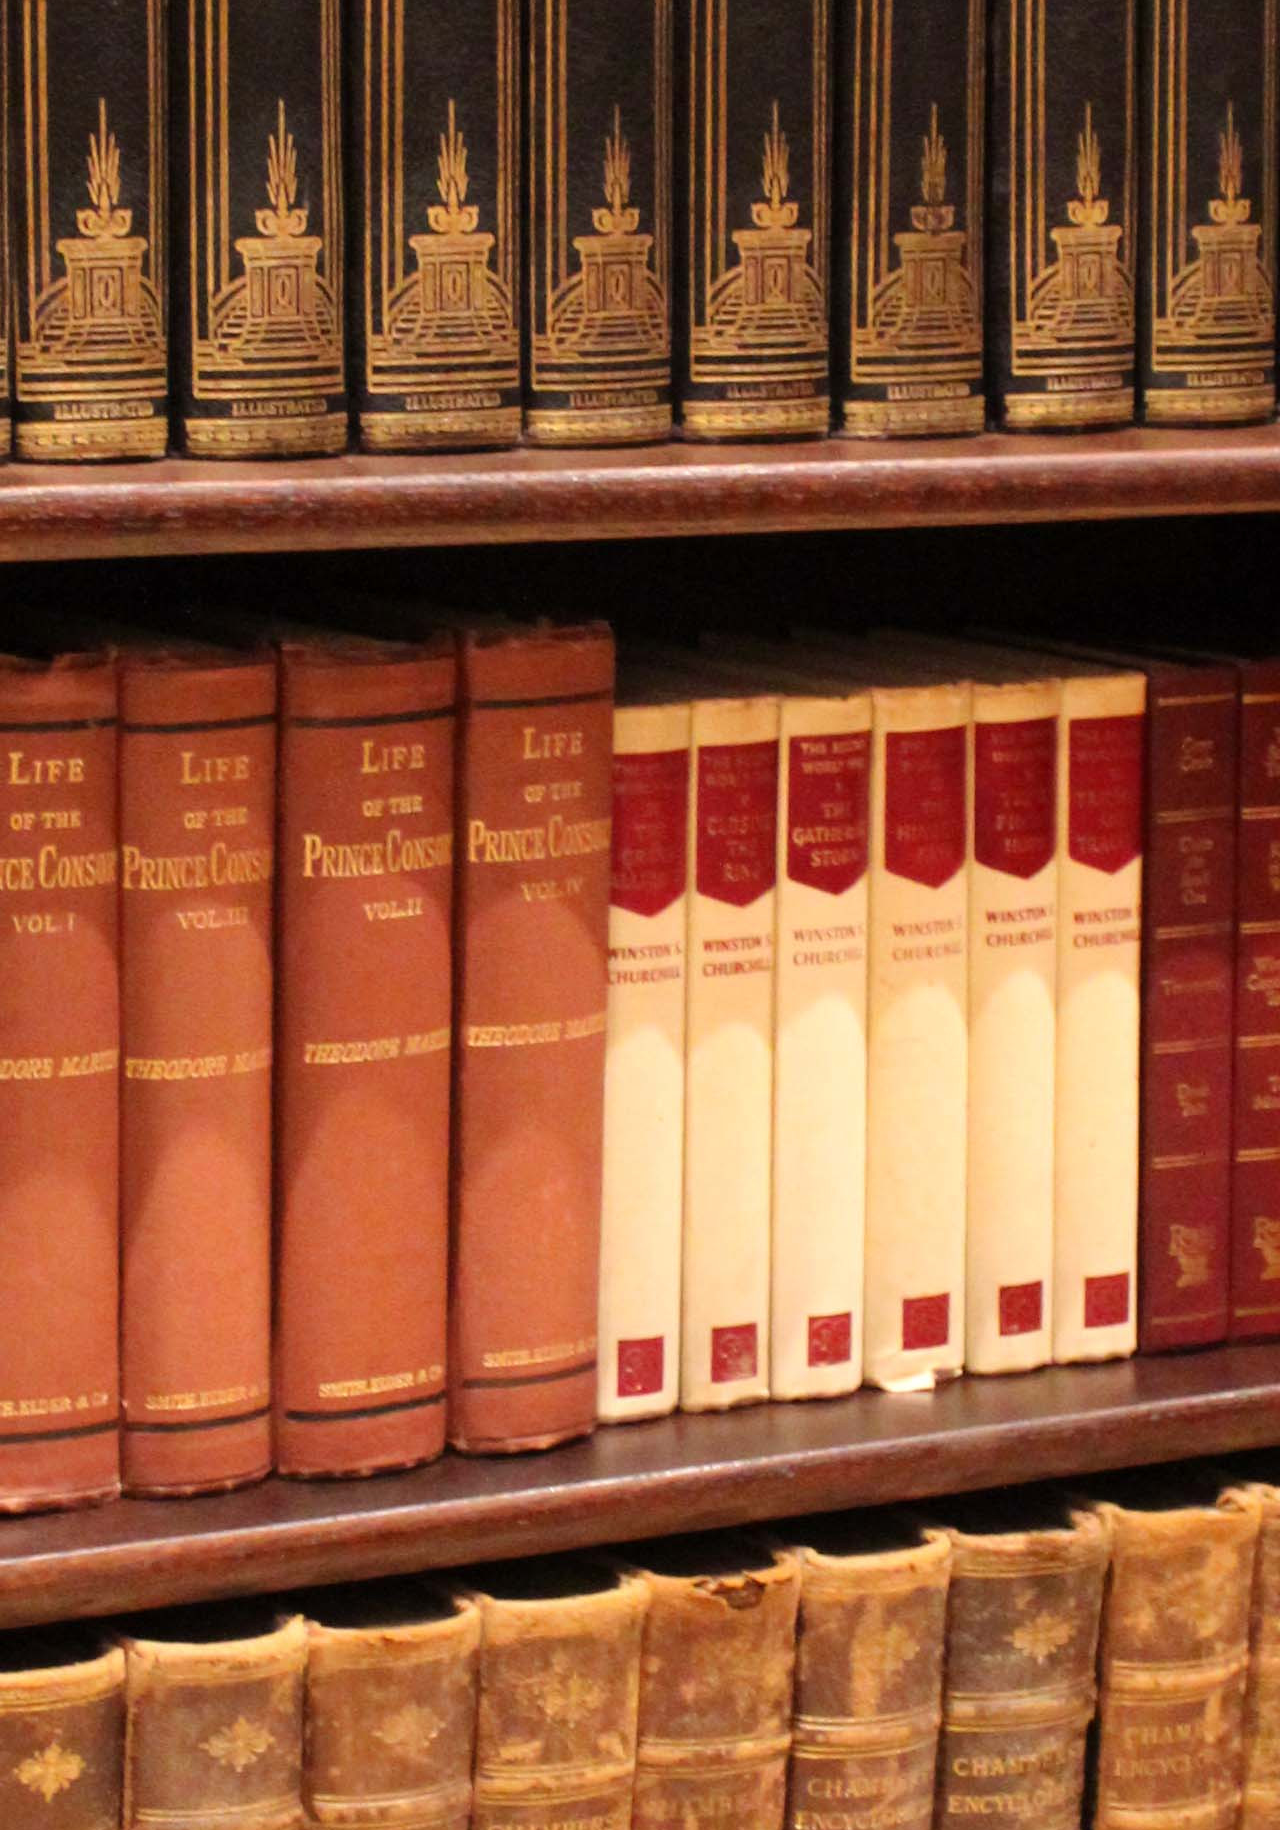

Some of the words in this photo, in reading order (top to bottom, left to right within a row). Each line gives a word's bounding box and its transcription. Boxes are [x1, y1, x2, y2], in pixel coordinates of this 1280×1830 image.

[361, 739, 426, 775] LIFE
[522, 726, 583, 760] LIFE
[8, 751, 85, 786] LIFE
[180, 750, 251, 785] LIFE
[362, 798, 385, 818] OF
[523, 783, 547, 804] OF
[9, 812, 36, 831] OF
[183, 810, 210, 830] OF
[302, 833, 385, 878] PRINCE
[467, 818, 546, 864] PRINCE
[122, 845, 209, 891] PRINCE
